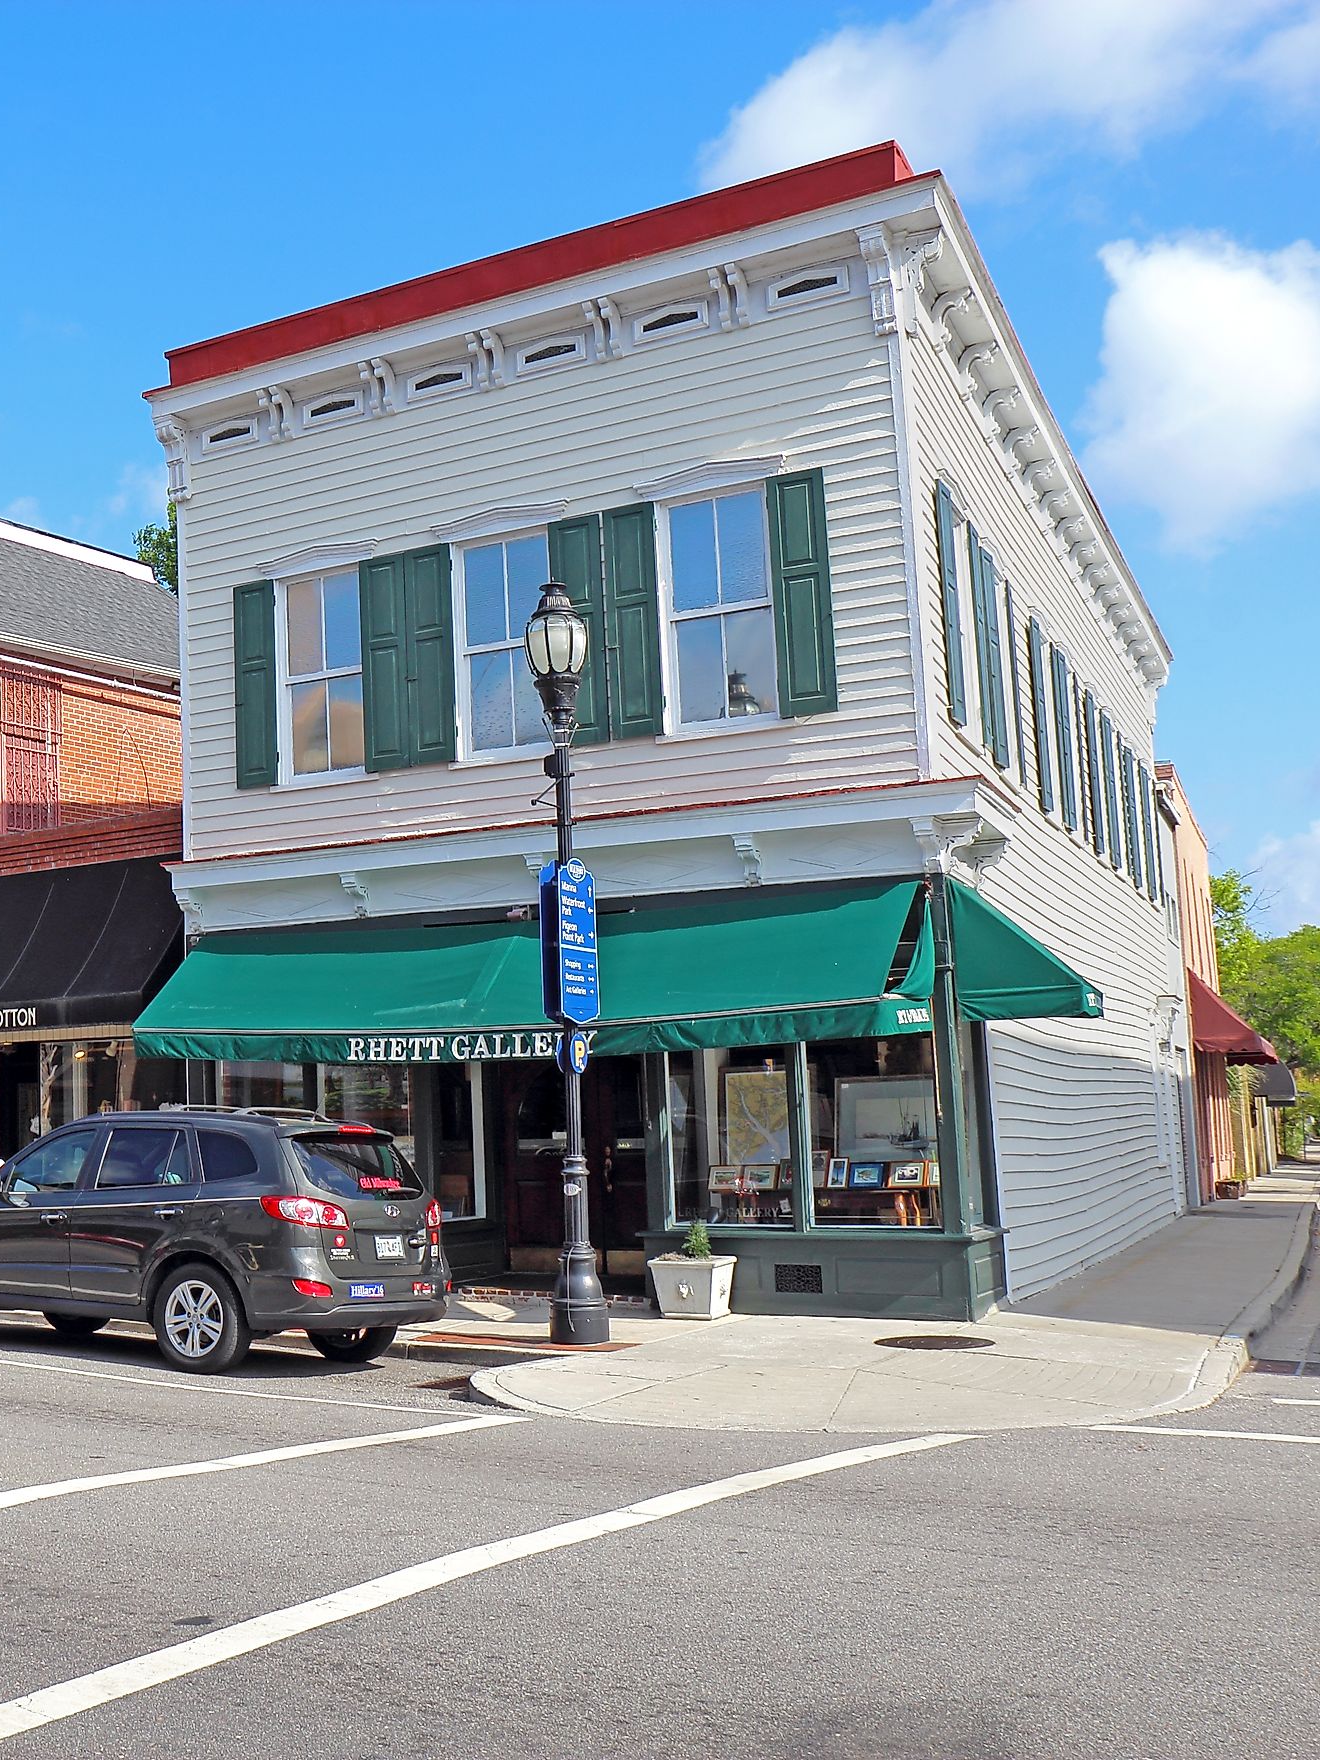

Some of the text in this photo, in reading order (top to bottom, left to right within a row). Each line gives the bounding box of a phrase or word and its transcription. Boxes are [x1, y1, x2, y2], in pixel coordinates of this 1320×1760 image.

[561, 881, 577, 893] Marina
[561, 895, 586, 909] Waterfront
[562, 905, 573, 916] Park
[562, 920, 578, 933] Pigeon
[562, 931, 585, 944] Point Park
[564, 959, 582, 970] Shopping
[347, 1030, 598, 1061] RHETT GALLEY
[574, 1040, 586, 1067] P
[726, 1206, 780, 1218] GALLERY
